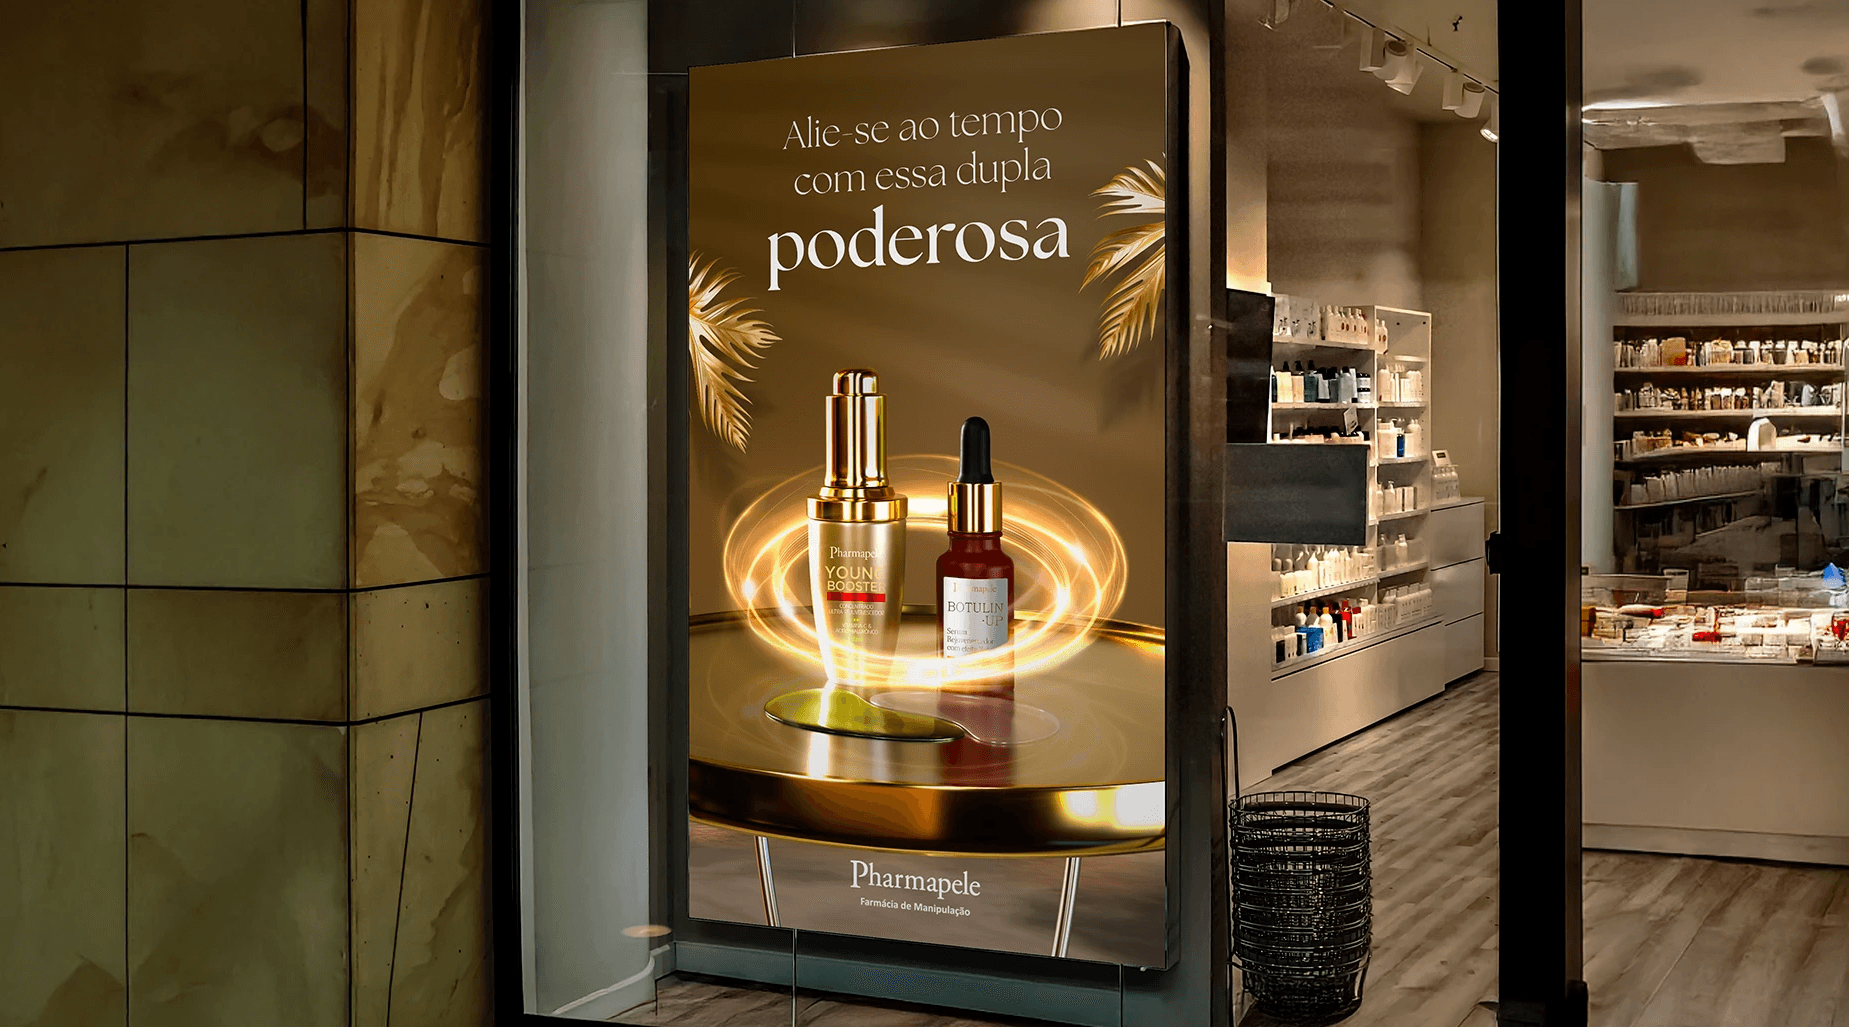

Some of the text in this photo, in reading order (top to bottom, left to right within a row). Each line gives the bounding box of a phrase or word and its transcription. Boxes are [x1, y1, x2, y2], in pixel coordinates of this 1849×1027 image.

[782, 107, 1063, 150] Alie-se ao tempo
[793, 147, 1051, 195] com essa dupla
[767, 204, 1071, 291] poderosa
[829, 545, 884, 561] Pharmapel
[827, 580, 886, 593] BOOSTER
[947, 600, 1004, 614] BOTULIN
[850, 860, 981, 900] Pharmapele
[860, 897, 971, 917] Farmácia de Manipulação
